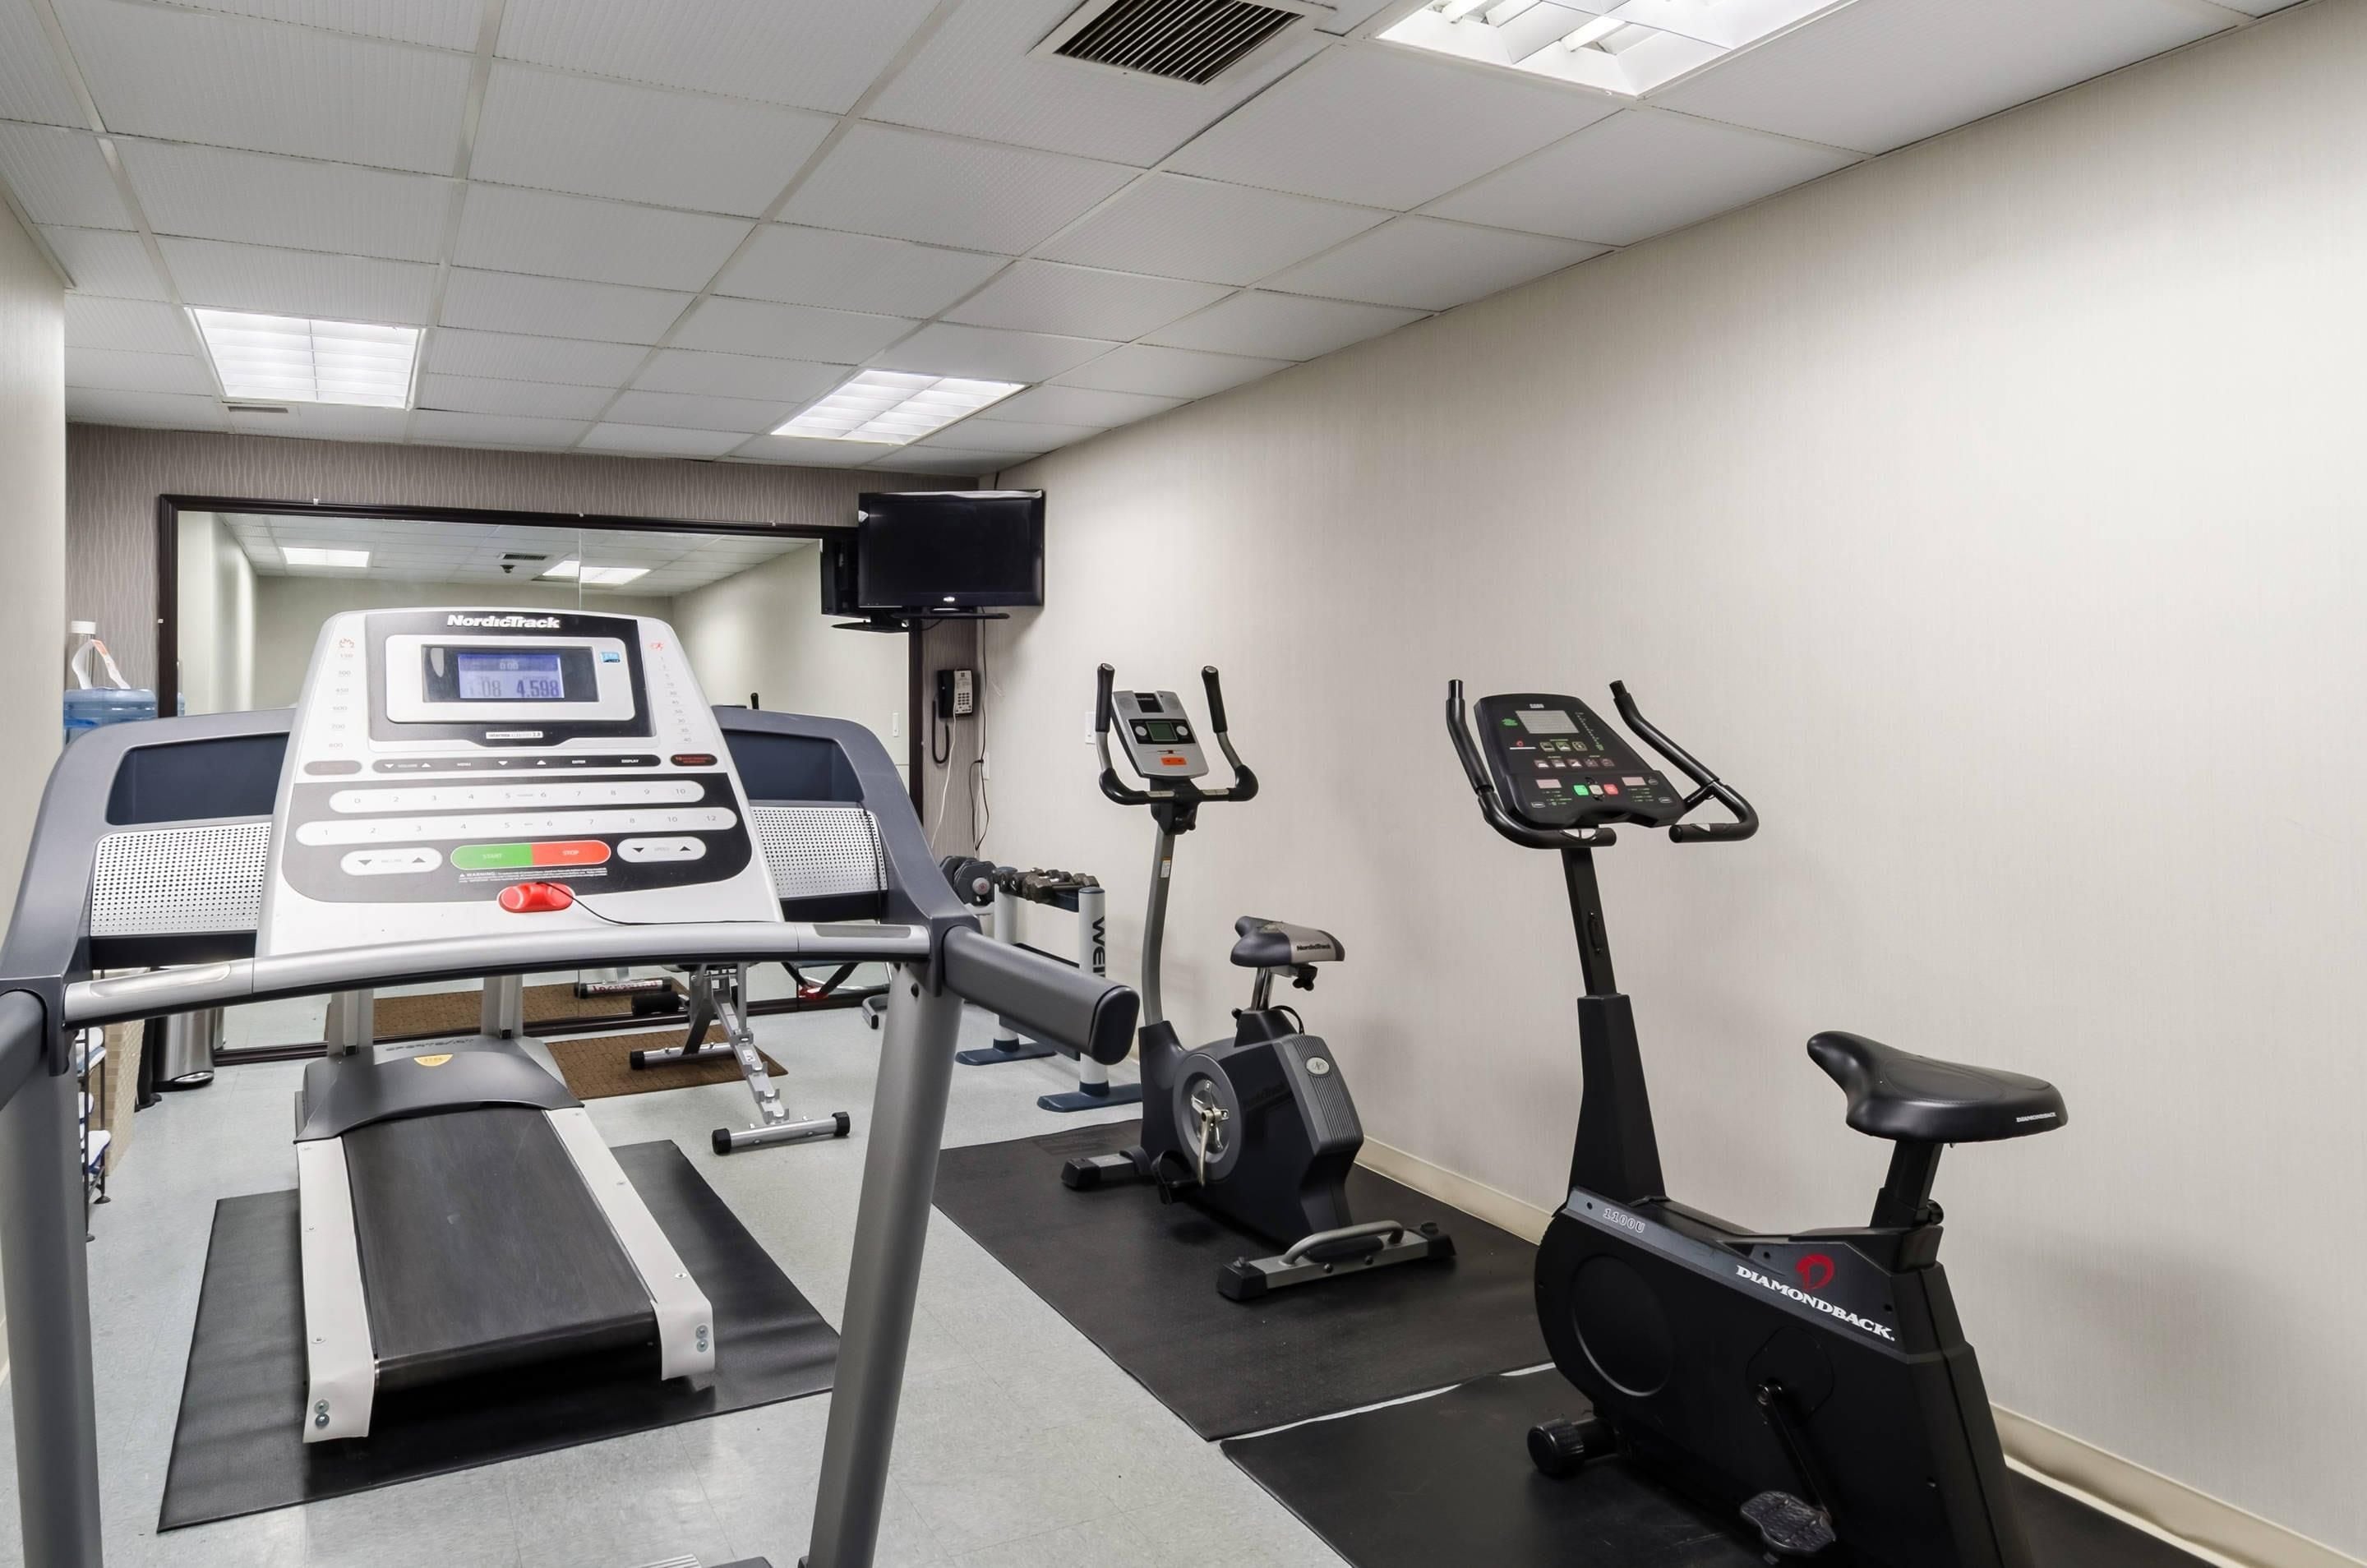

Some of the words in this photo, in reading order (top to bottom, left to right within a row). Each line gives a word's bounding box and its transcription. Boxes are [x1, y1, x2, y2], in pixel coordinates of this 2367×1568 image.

[446, 615, 561, 629] NordicTrack
[1092, 915, 1105, 978] WEI
[1603, 1208, 1645, 1234] 1100U
